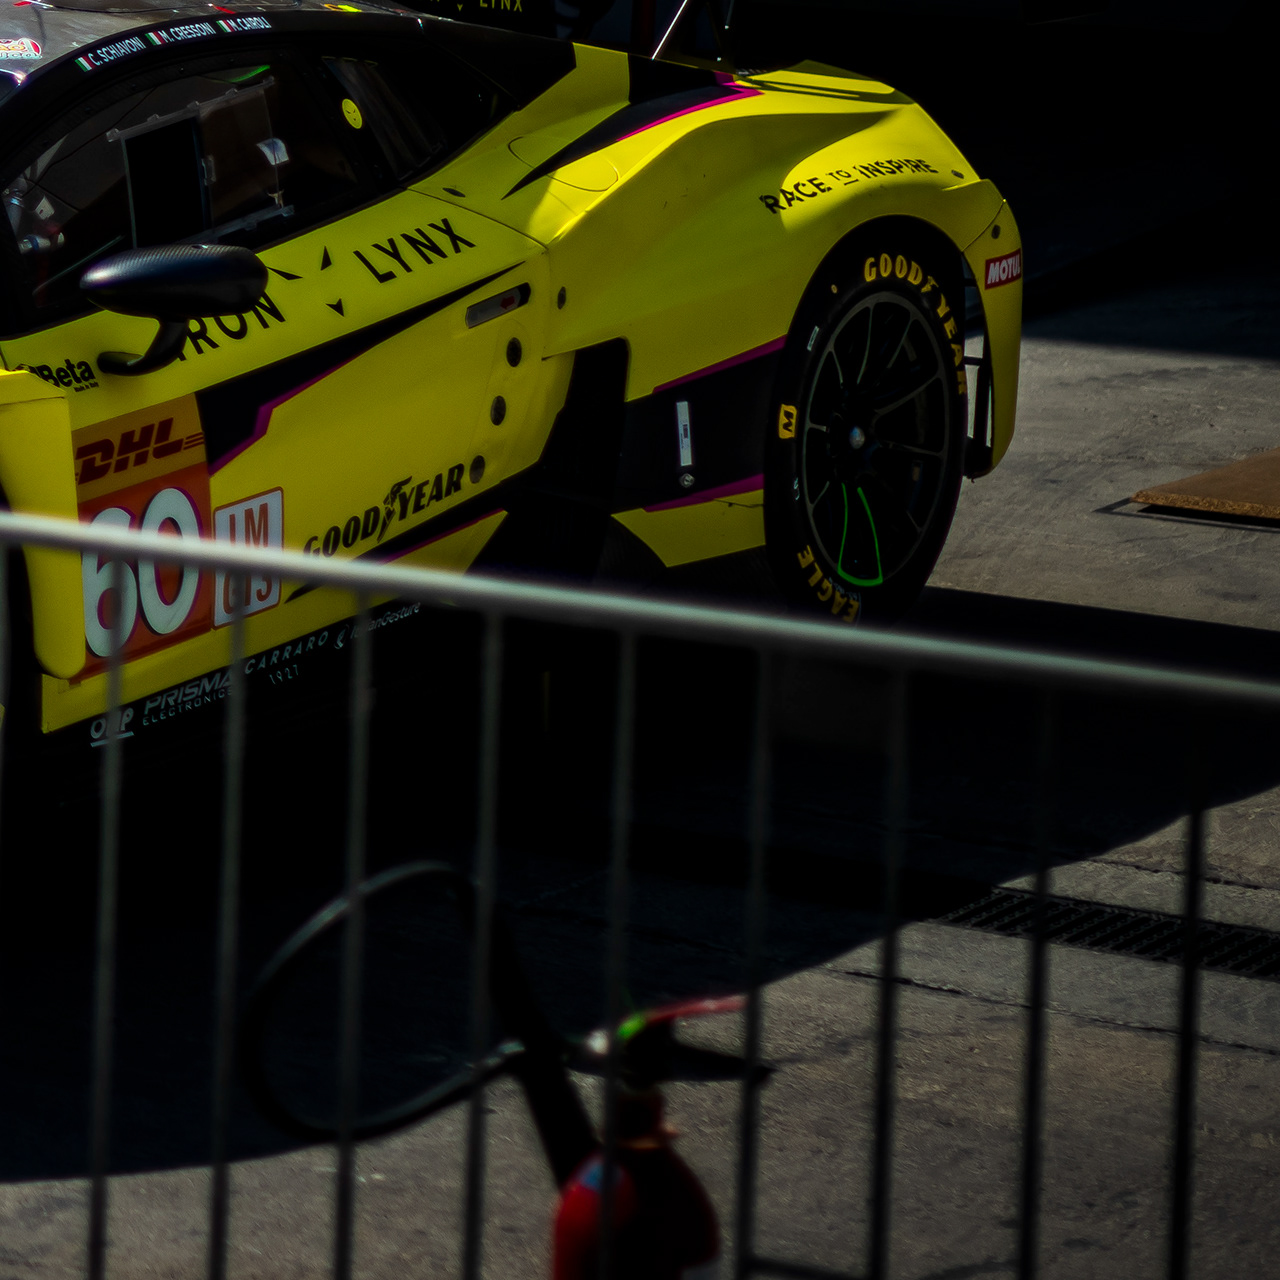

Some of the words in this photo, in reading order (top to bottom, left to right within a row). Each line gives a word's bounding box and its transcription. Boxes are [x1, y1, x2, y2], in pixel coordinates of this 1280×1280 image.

[758, 176, 832, 214] RACE
[825, 169, 852, 183] TO
[852, 158, 939, 180] INSPIRE
[353, 217, 476, 283] LYNX
[987, 251, 1021, 285] MOTUL
[178, 290, 285, 362] RON
[37, 359, 96, 388] Beta
[75, 417, 185, 485] DHL
[81, 487, 204, 658] 60
[796, 544, 860, 623] EAGLE
[244, 629, 329, 676] CARRARO
[268, 663, 300, 686] 1927
[91, 706, 135, 739] OP
